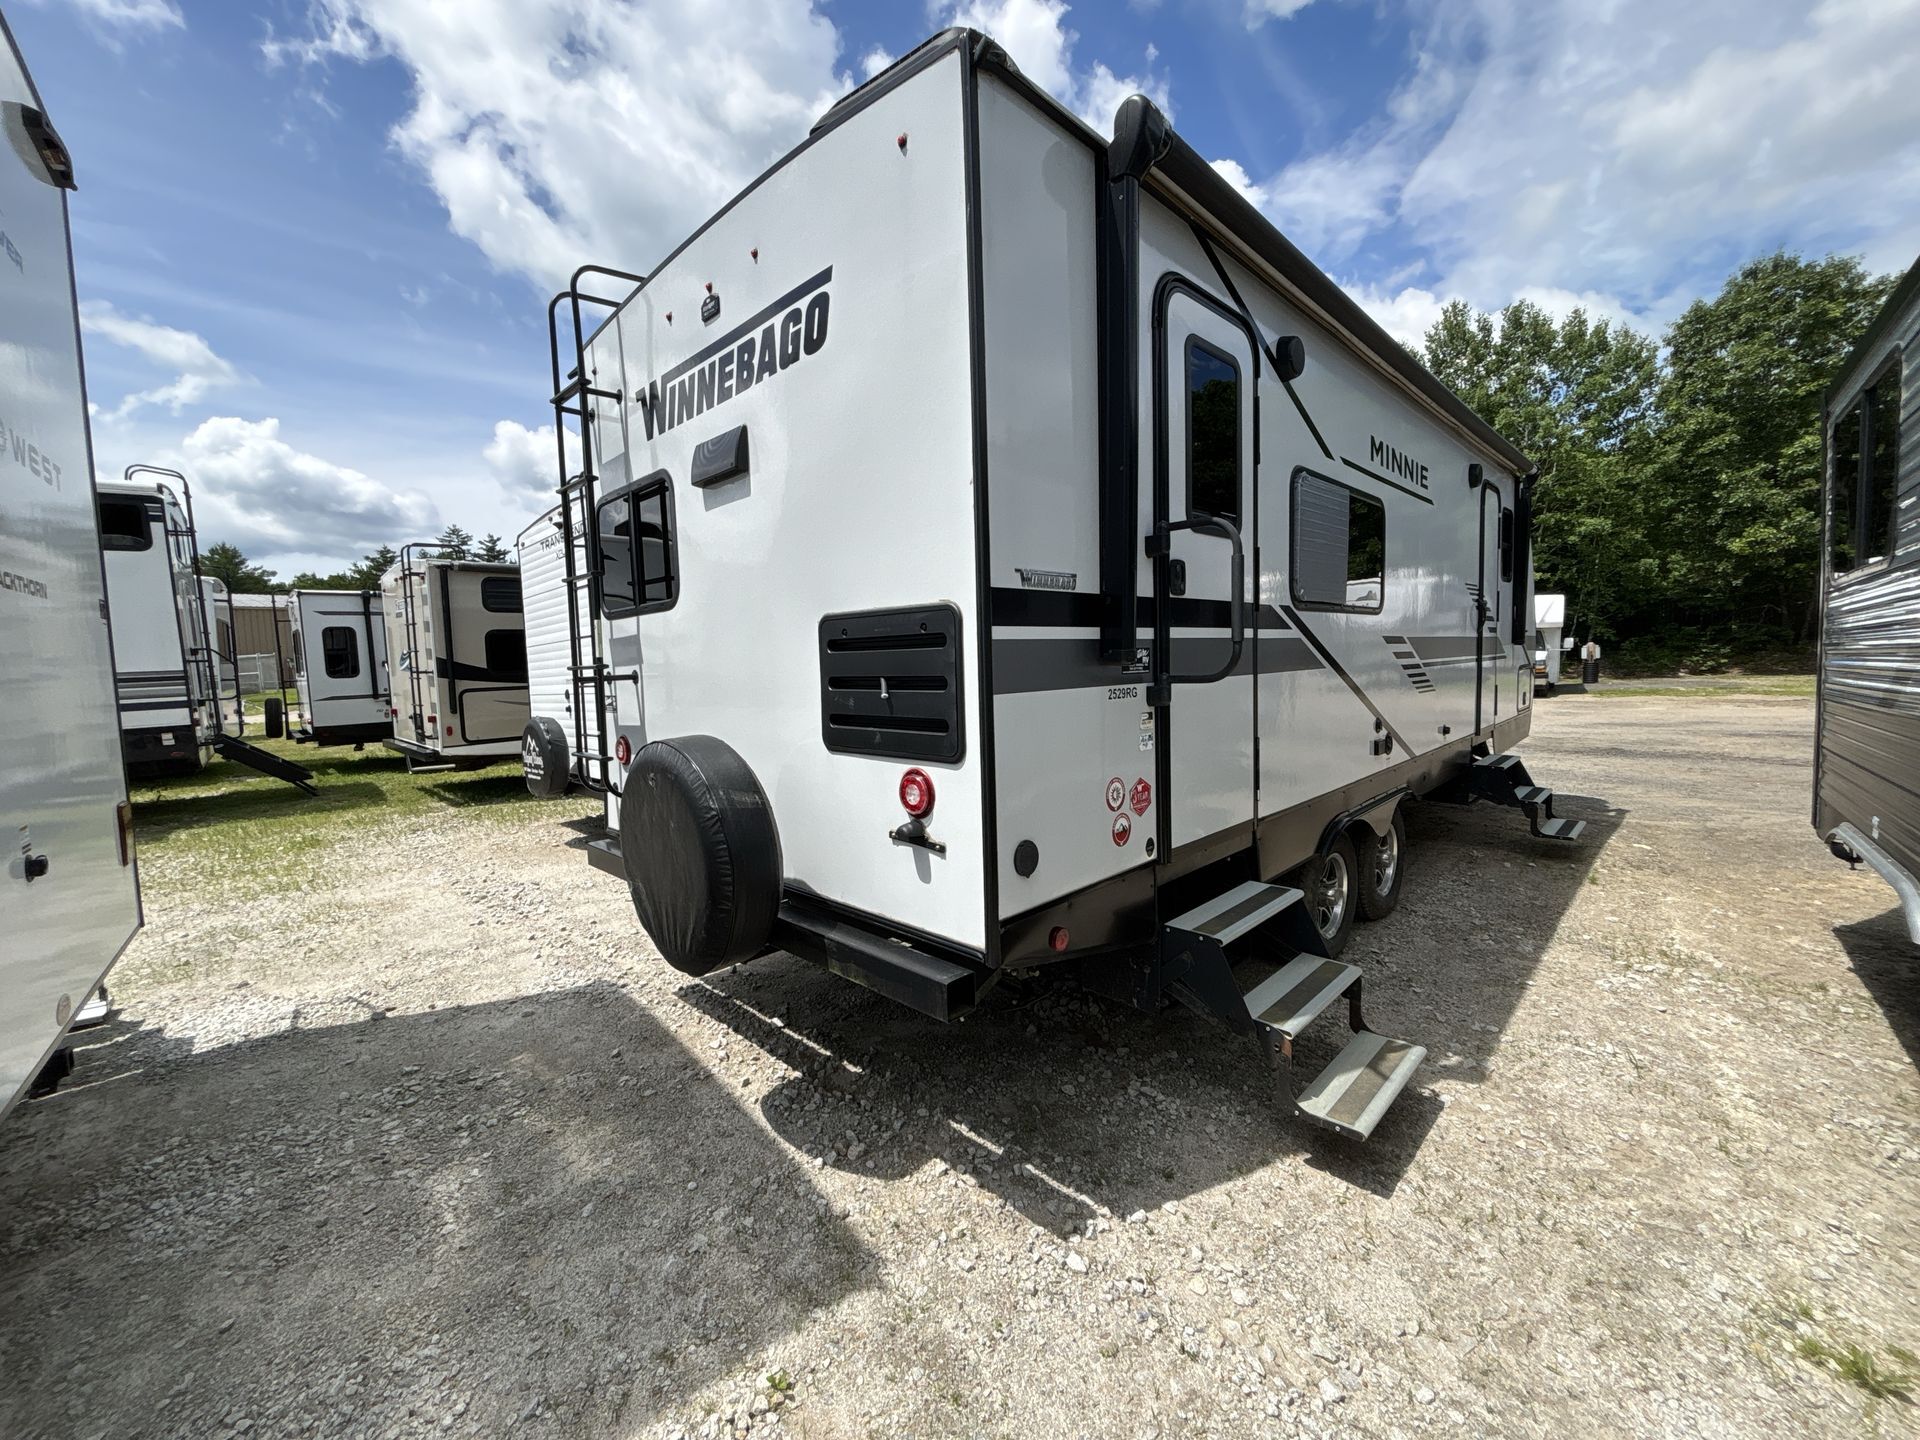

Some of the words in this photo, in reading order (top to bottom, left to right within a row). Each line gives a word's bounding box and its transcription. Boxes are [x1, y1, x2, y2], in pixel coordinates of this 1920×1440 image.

[635, 291, 830, 441] WINNEBAGO
[9, 428, 61, 492] WEST
[1370, 434, 1429, 490] MINNIE
[1108, 687, 1138, 700] 2529RG
